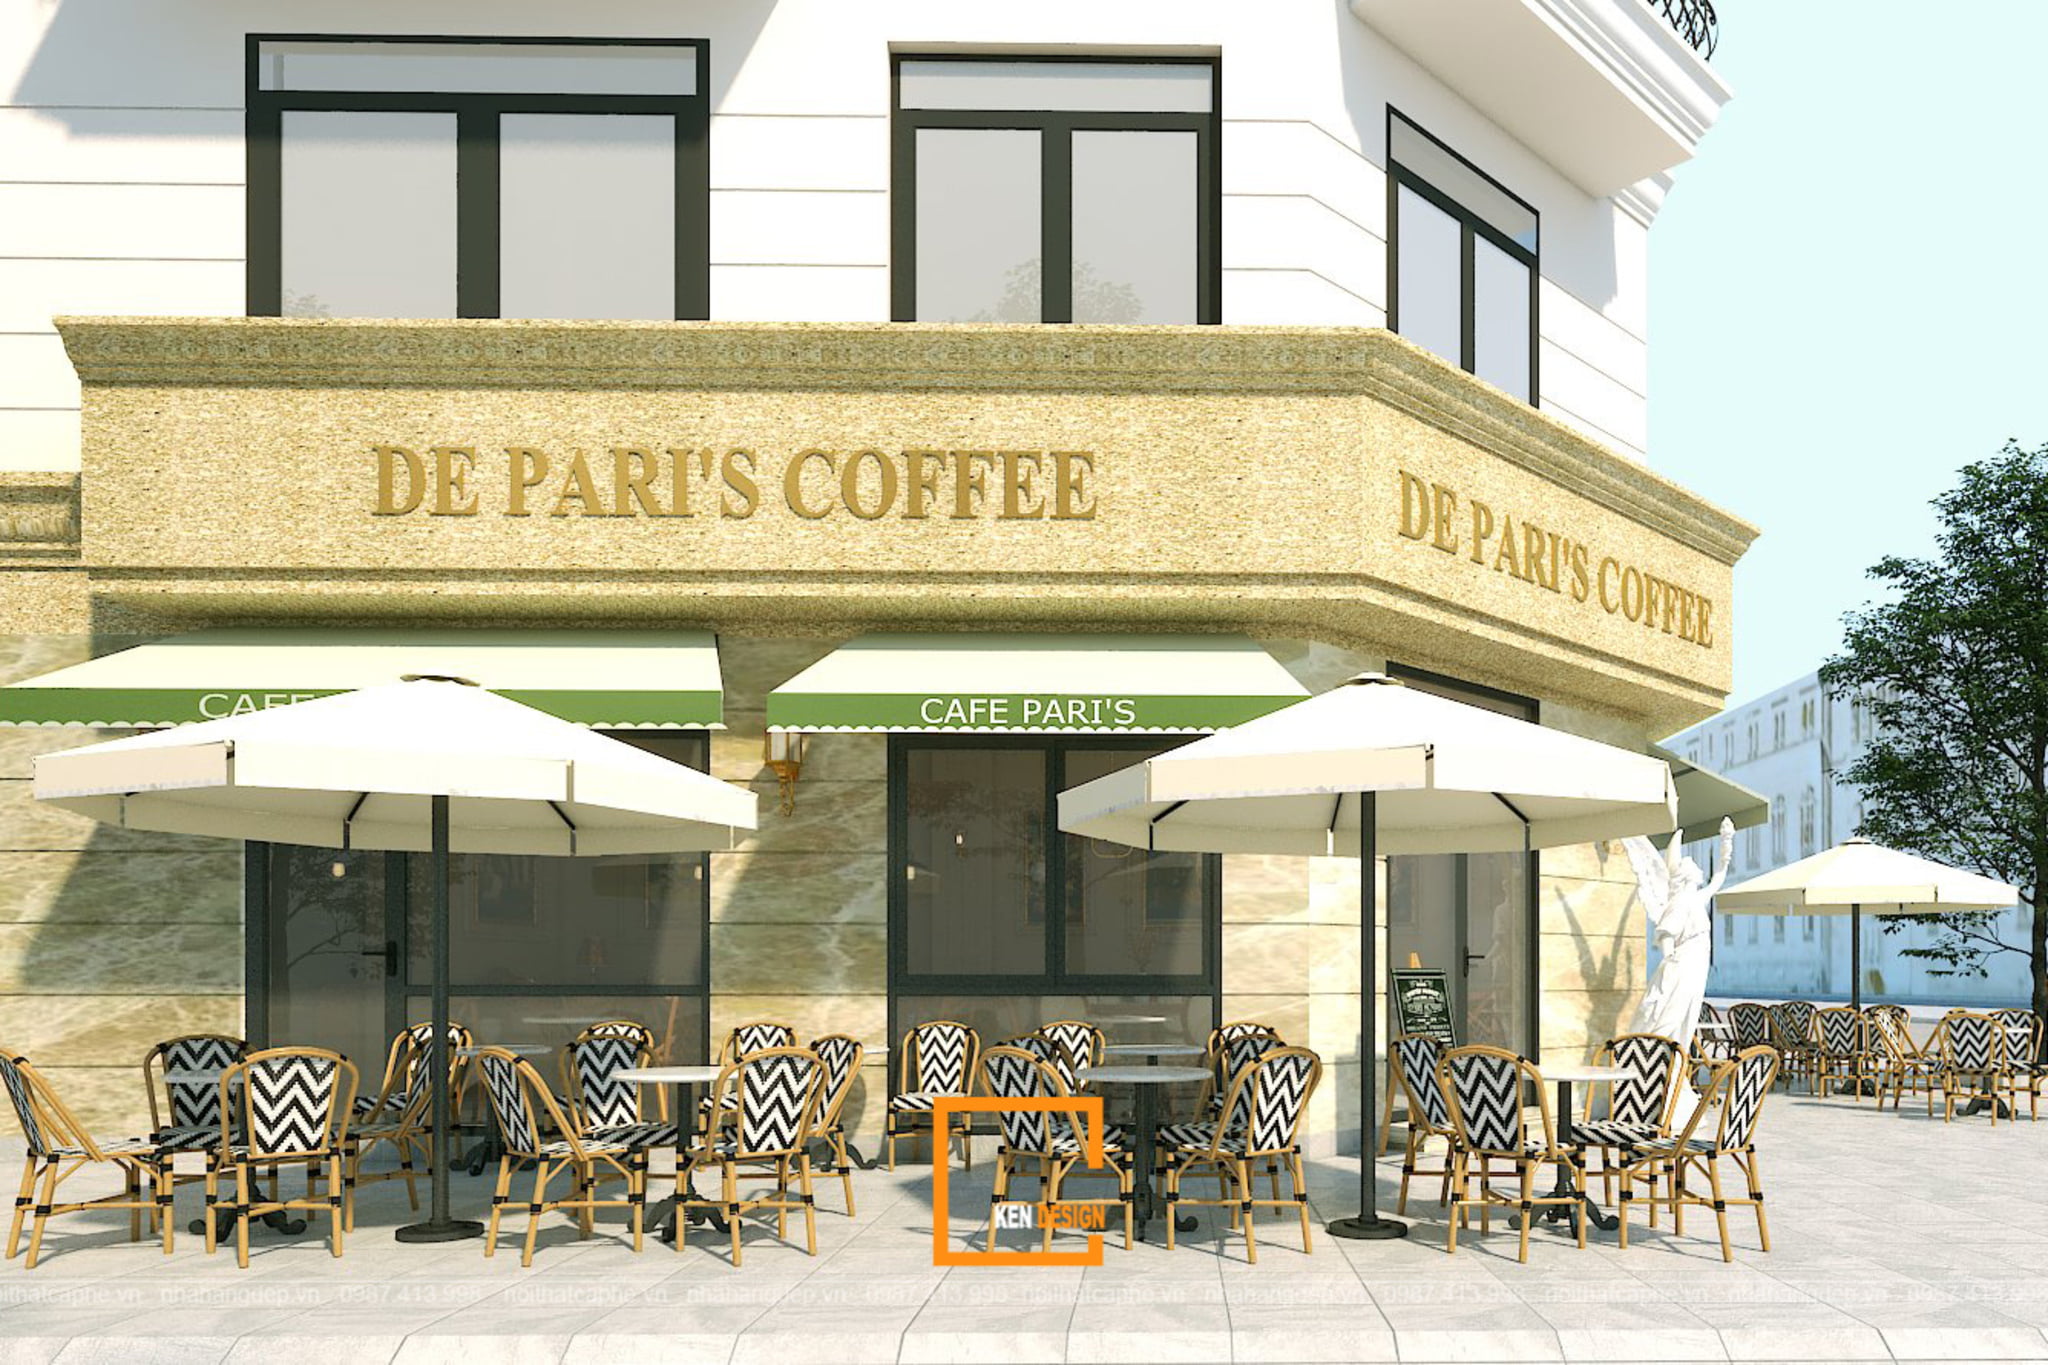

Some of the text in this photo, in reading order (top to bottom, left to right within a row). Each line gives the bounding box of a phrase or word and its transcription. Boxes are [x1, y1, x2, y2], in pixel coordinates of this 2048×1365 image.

[371, 447, 1098, 520] DE PARI'S COFFEE
[1398, 469, 1713, 648] DE PARI'S COFFEE
[920, 698, 1136, 725] CAFE PARI'S
